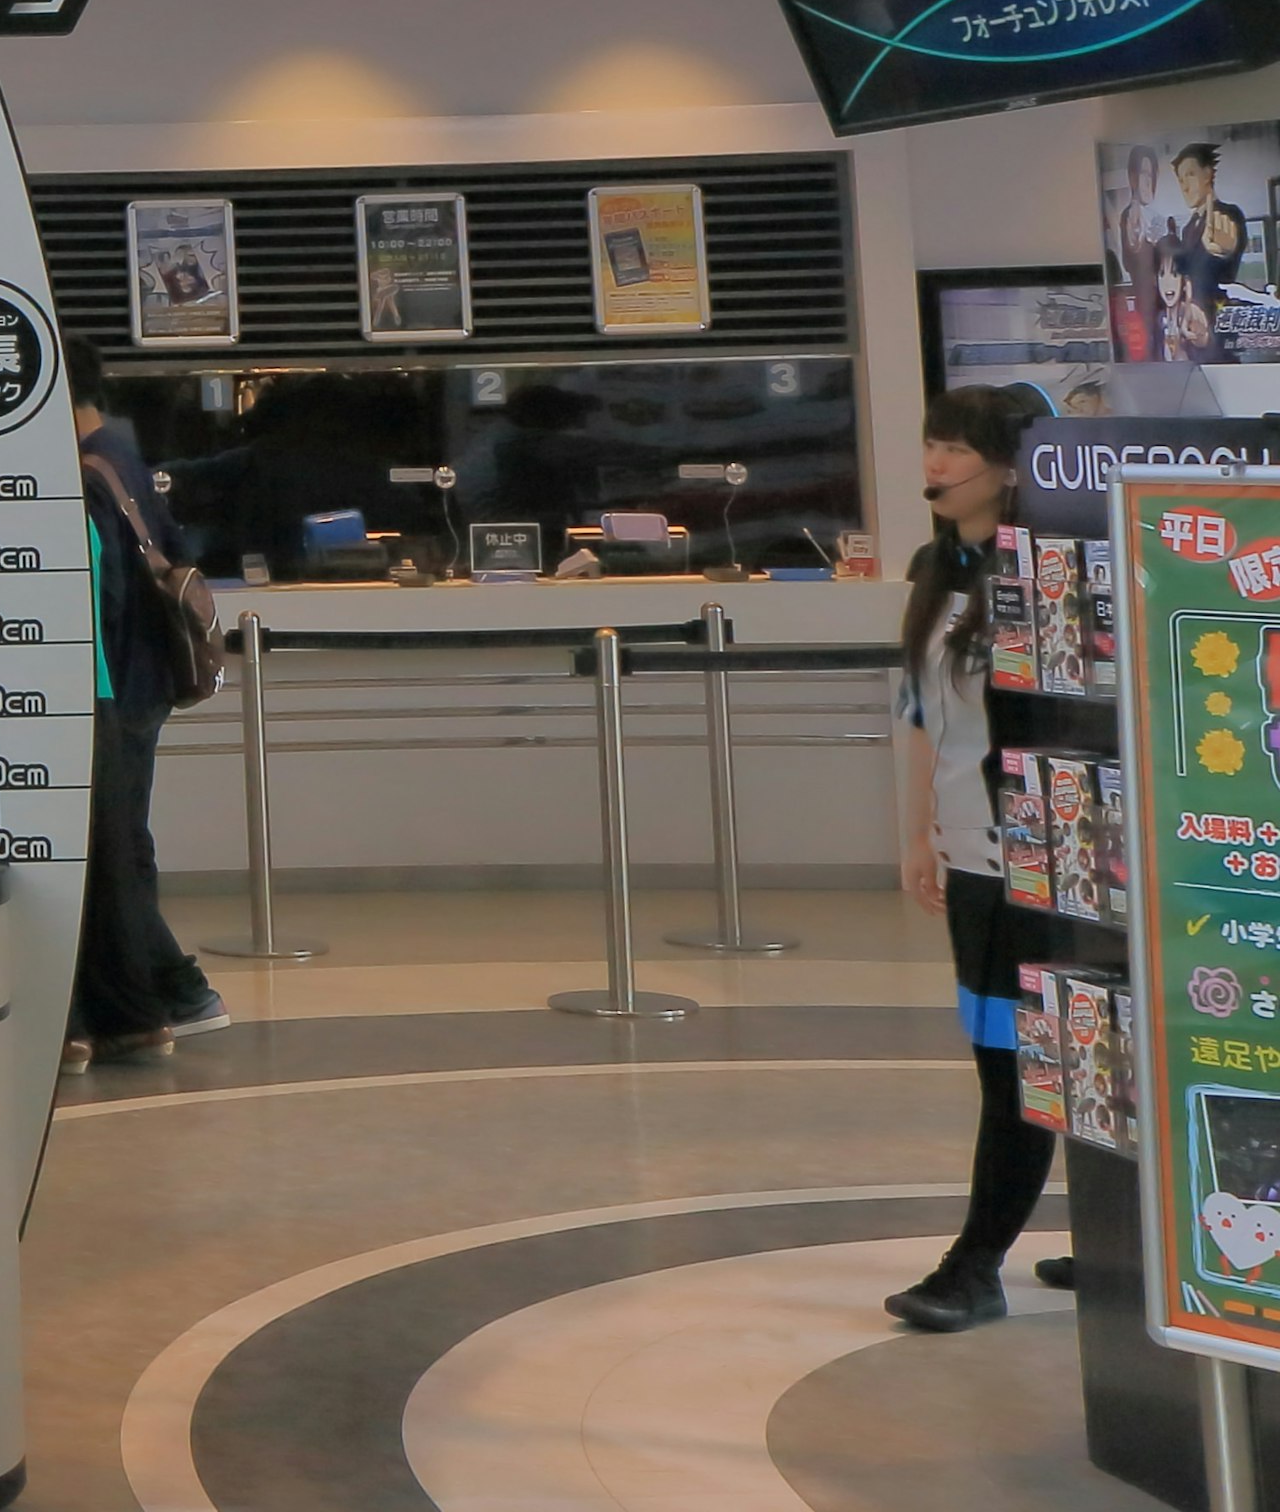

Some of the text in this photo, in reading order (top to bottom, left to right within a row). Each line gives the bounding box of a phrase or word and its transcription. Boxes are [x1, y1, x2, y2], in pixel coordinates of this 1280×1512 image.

[208, 377, 224, 408] 1
[476, 371, 503, 401] 2
[769, 364, 798, 394] 3
[1160, 511, 1226, 557] 平日
